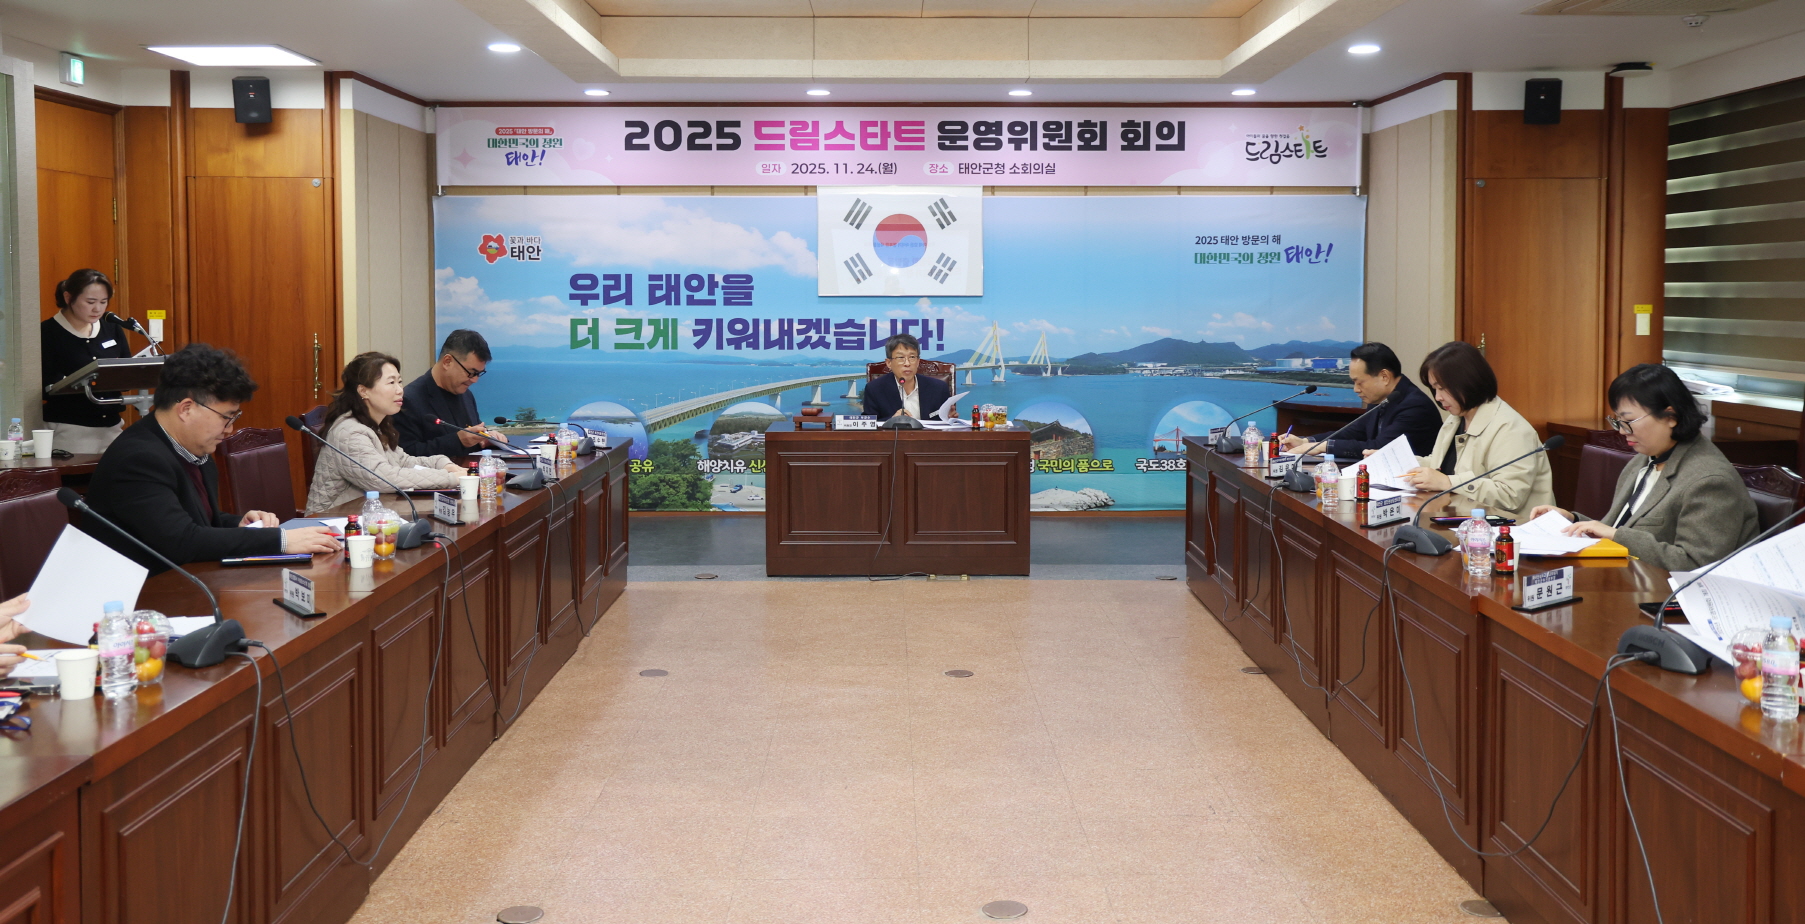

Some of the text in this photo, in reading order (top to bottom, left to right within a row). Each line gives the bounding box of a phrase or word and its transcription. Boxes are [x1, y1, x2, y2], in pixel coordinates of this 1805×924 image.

[487, 138, 563, 148] 대한민국의 정원
[624, 120, 1186, 152] 2025 드림스타트 운영위원회 회의
[1245, 132, 1328, 164] 드림스타트
[505, 149, 546, 166] 태안!
[761, 162, 898, 175] 일자 2025. 11. 24.(월)
[928, 162, 1056, 175] 장소 태안군청 소회의실
[509, 236, 541, 244] 꽃과 바다
[1195, 234, 1282, 245] 2025 태안 방문의 해
[510, 245, 542, 260] 태안
[1194, 242, 1334, 264] 대한민국의 정원 태안!
[569, 273, 755, 306] 우리 태안을
[569, 318, 945, 351] 더 크게 키워내겠습니다!
[629, 459, 654, 473] 공유
[696, 459, 747, 473] 해양치유
[1038, 458, 1074, 473] 국민의
[1077, 458, 1114, 473] 품으로
[1136, 458, 1186, 472] 국도38호
[1536, 582, 1564, 600] 문원근
